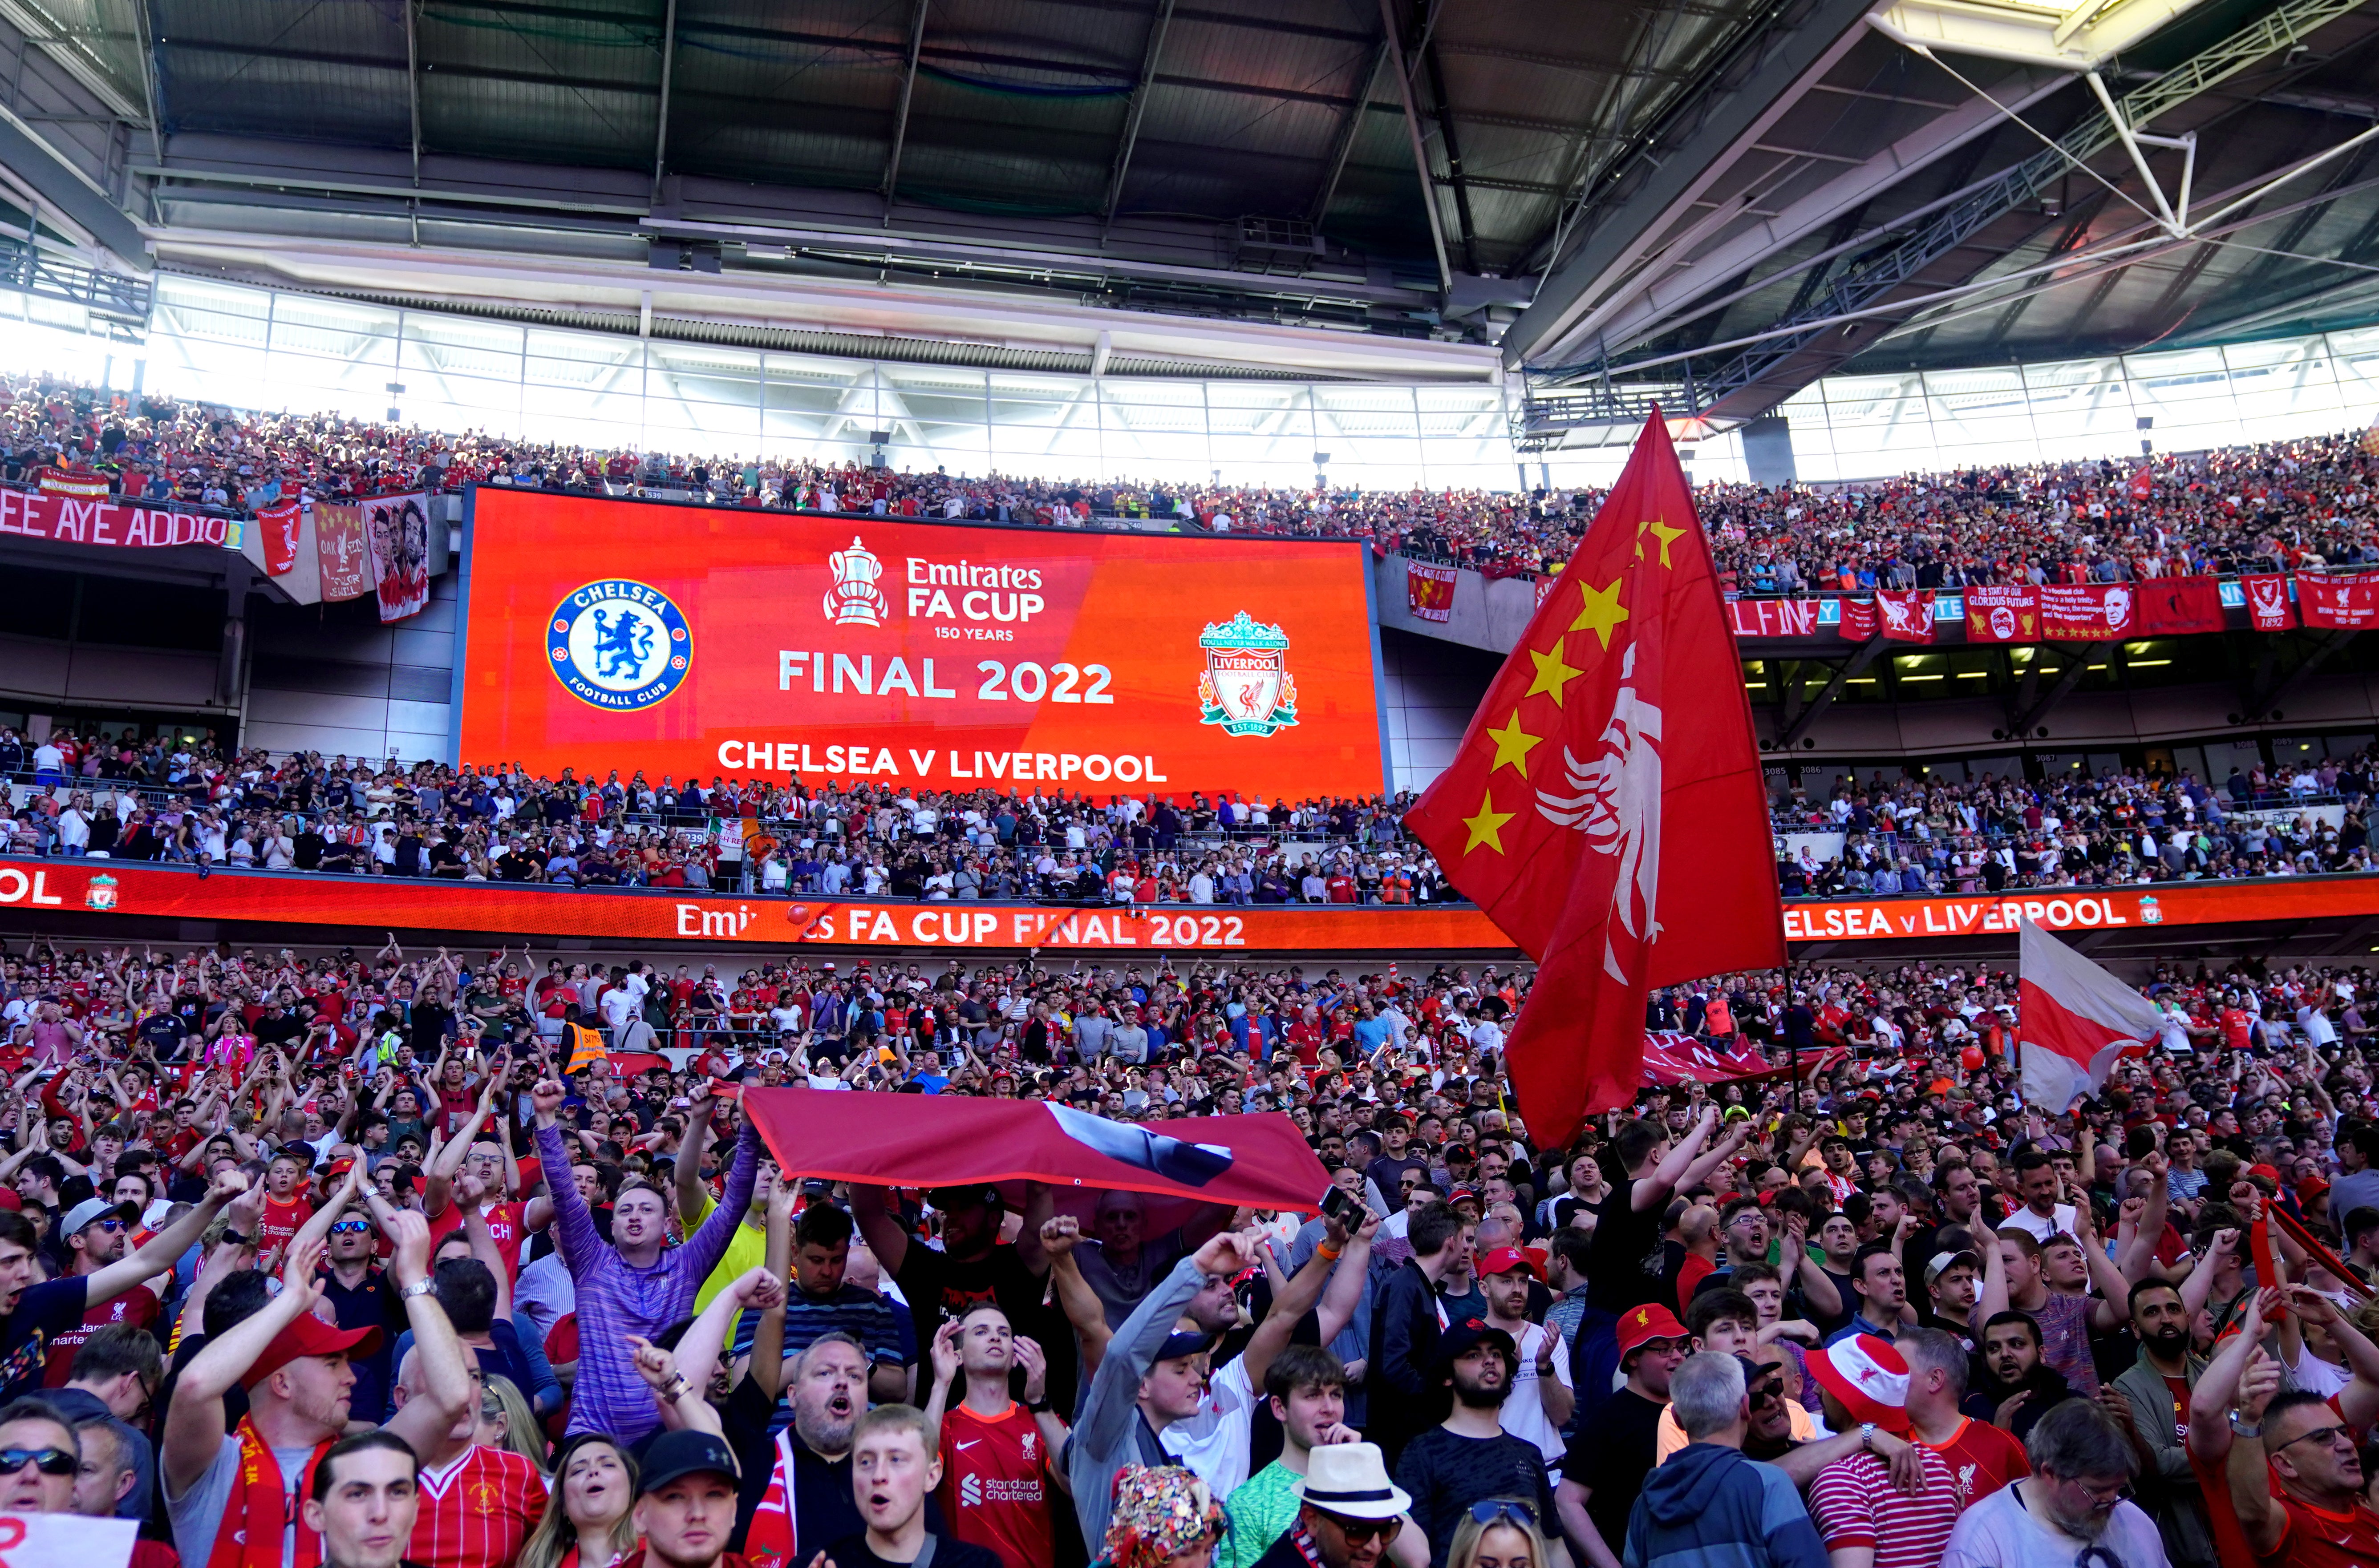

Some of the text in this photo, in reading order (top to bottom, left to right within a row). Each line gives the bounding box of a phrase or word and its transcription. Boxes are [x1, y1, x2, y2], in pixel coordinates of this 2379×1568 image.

[648, 491, 662, 499] 539
[54, 496, 118, 544] AYE
[125, 507, 228, 546] ADDIO
[321, 540, 336, 555] OAK
[907, 558, 1042, 590] Emirates
[2310, 576, 2328, 584] WORLD
[2344, 577, 2357, 585] LOST
[1978, 586, 2022, 596] THE START OF OUR
[574, 583, 668, 616] CHELSEA
[908, 588, 1045, 622] FA CUP
[1969, 595, 2035, 607] GLORIOUS FUTURE
[2065, 596, 2076, 604] holy
[2261, 617, 2284, 628] 1892
[935, 627, 1014, 642] 150 YEARS
[1214, 658, 1278, 671] LIVERPOOL
[779, 650, 1114, 704] FINAL 2022
[569, 676, 668, 705] FOOTBALL CLUB
[718, 740, 1167, 783] CHELSEA V LIVERPOOL
[1764, 767, 1786, 775] 3085
[1800, 766, 1821, 774] 3086
[850, 910, 900, 942] FA
[912, 912, 998, 944] CUP
[1151, 916, 1245, 946] 2022
[986, 1478, 1039, 1490] standard
[986, 1489, 1043, 1501] chartered
